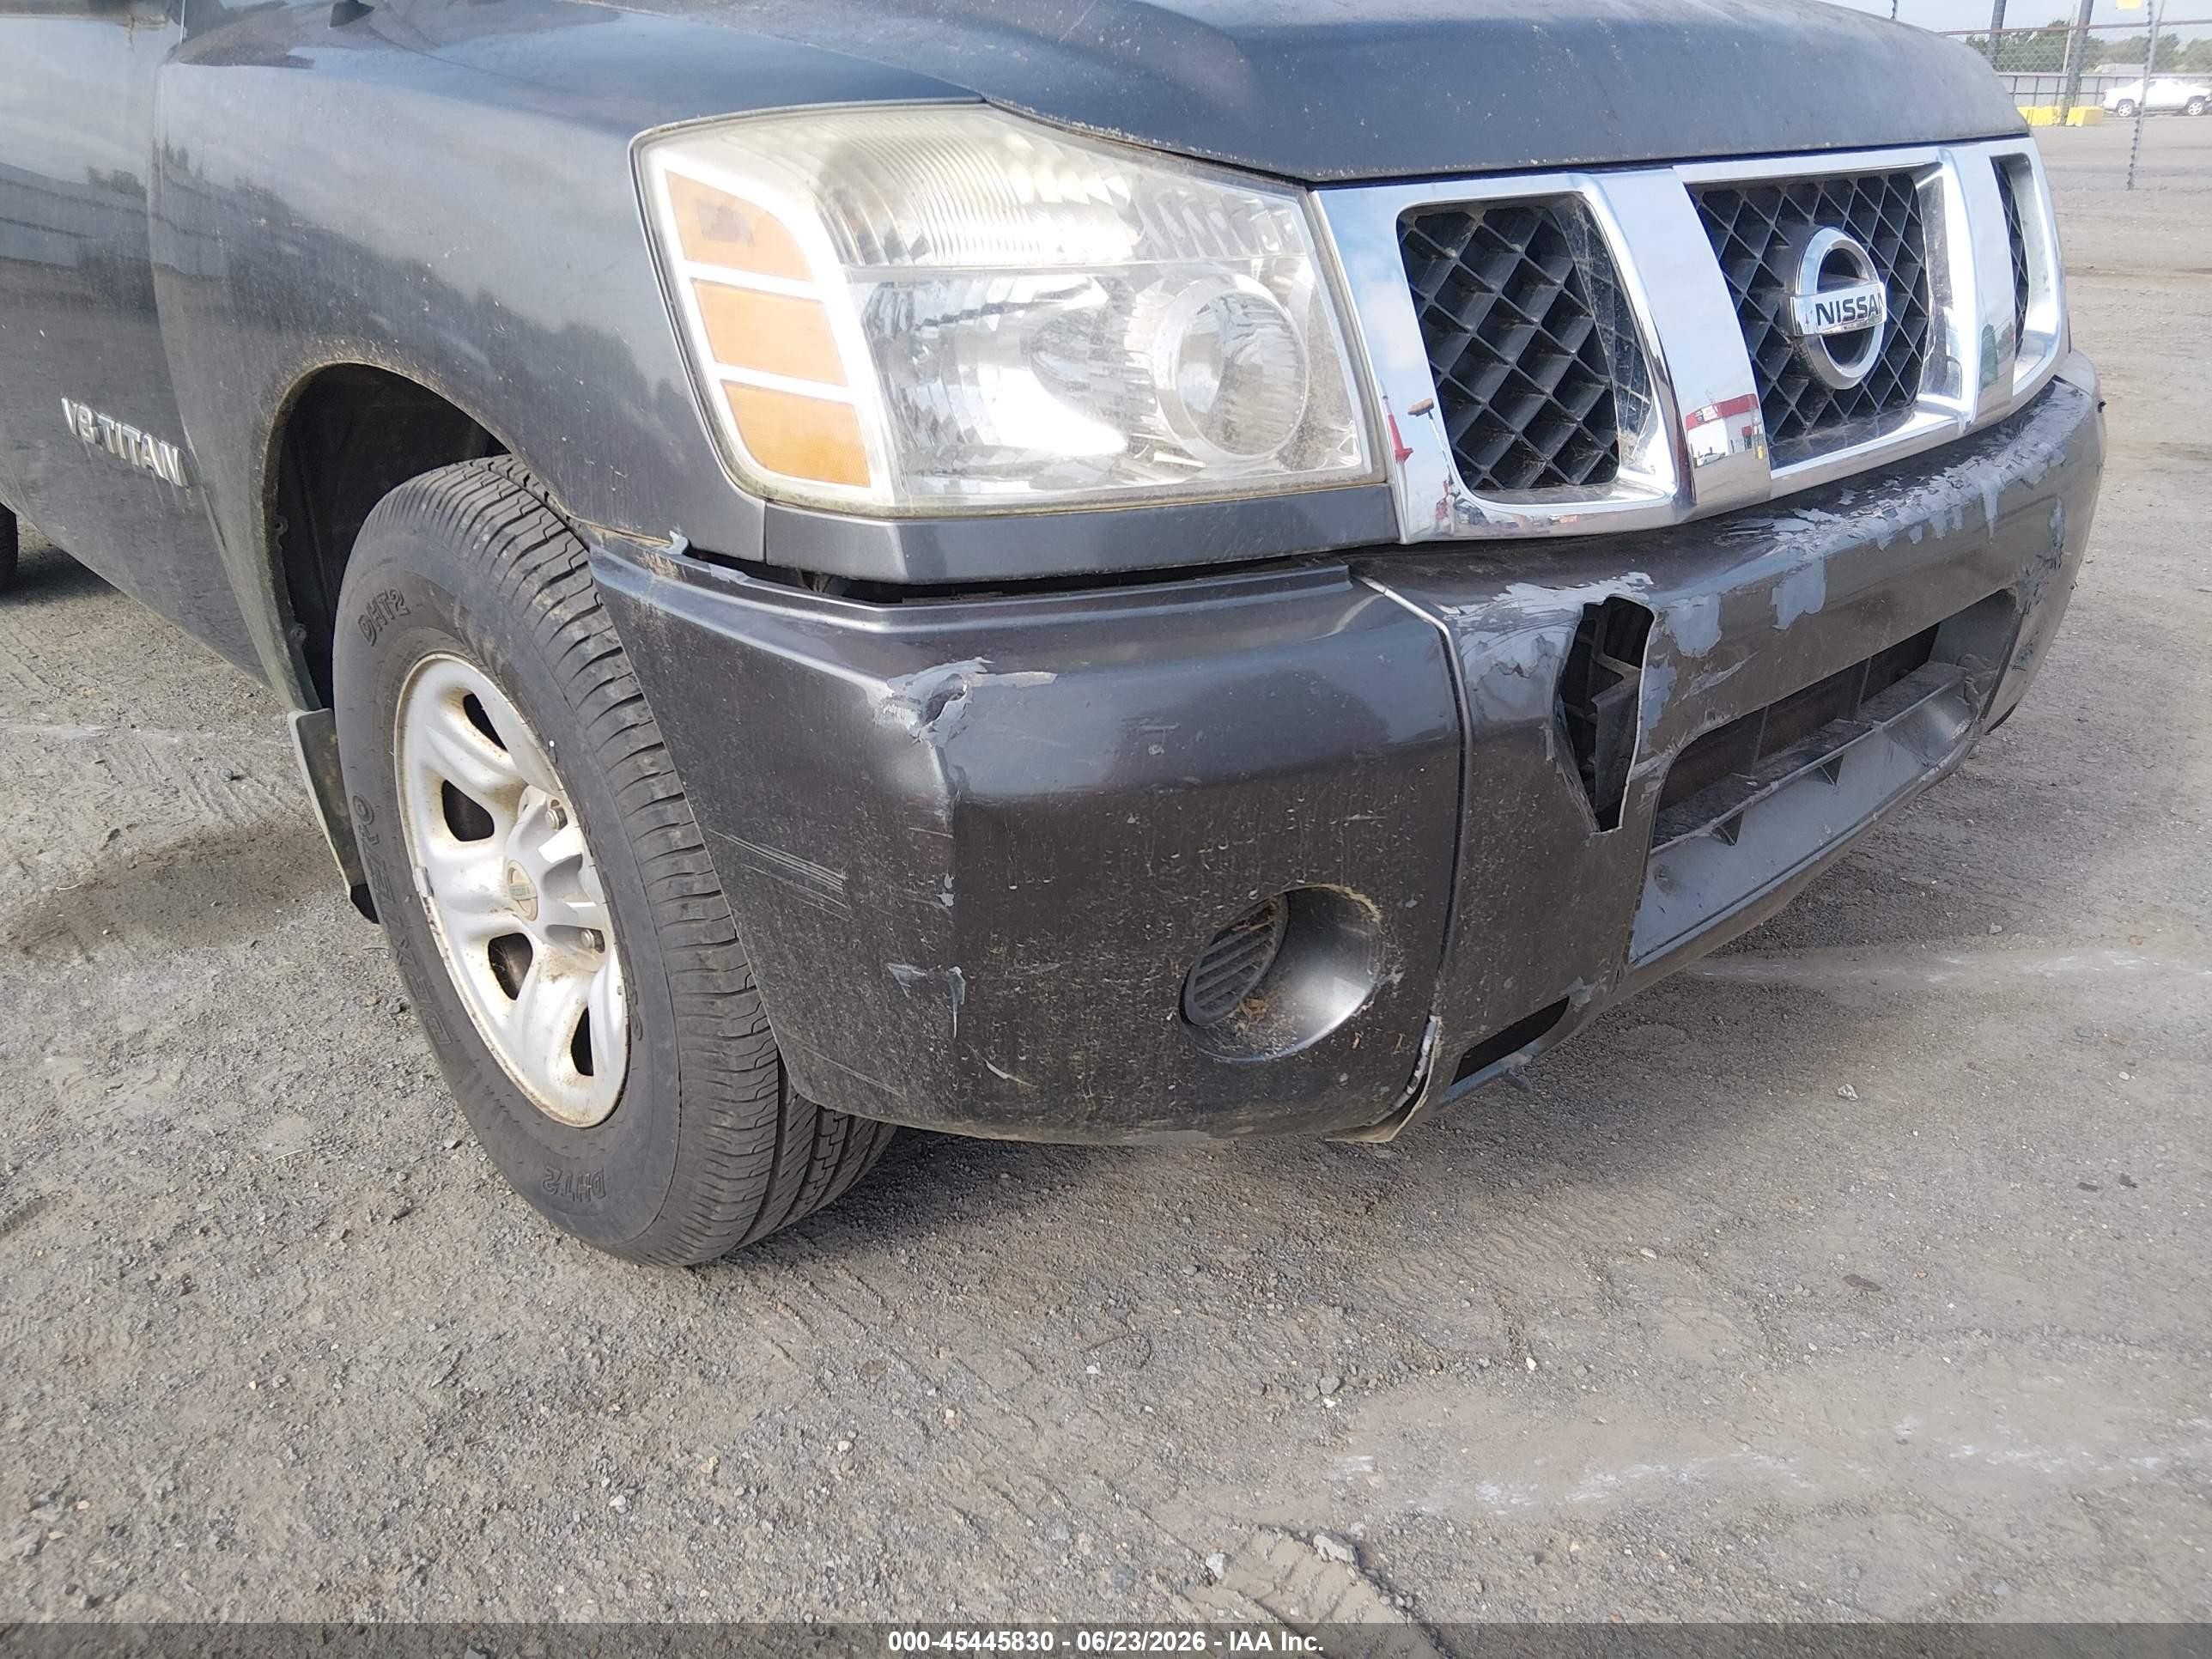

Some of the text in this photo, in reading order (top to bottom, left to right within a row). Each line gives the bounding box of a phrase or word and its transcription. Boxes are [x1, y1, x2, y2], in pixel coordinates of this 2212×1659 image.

[1814, 294, 1885, 326] NISSAN
[61, 398, 188, 487] V8 TITAN
[357, 587, 411, 647] DHT2
[542, 1165, 607, 1203] DHT2
